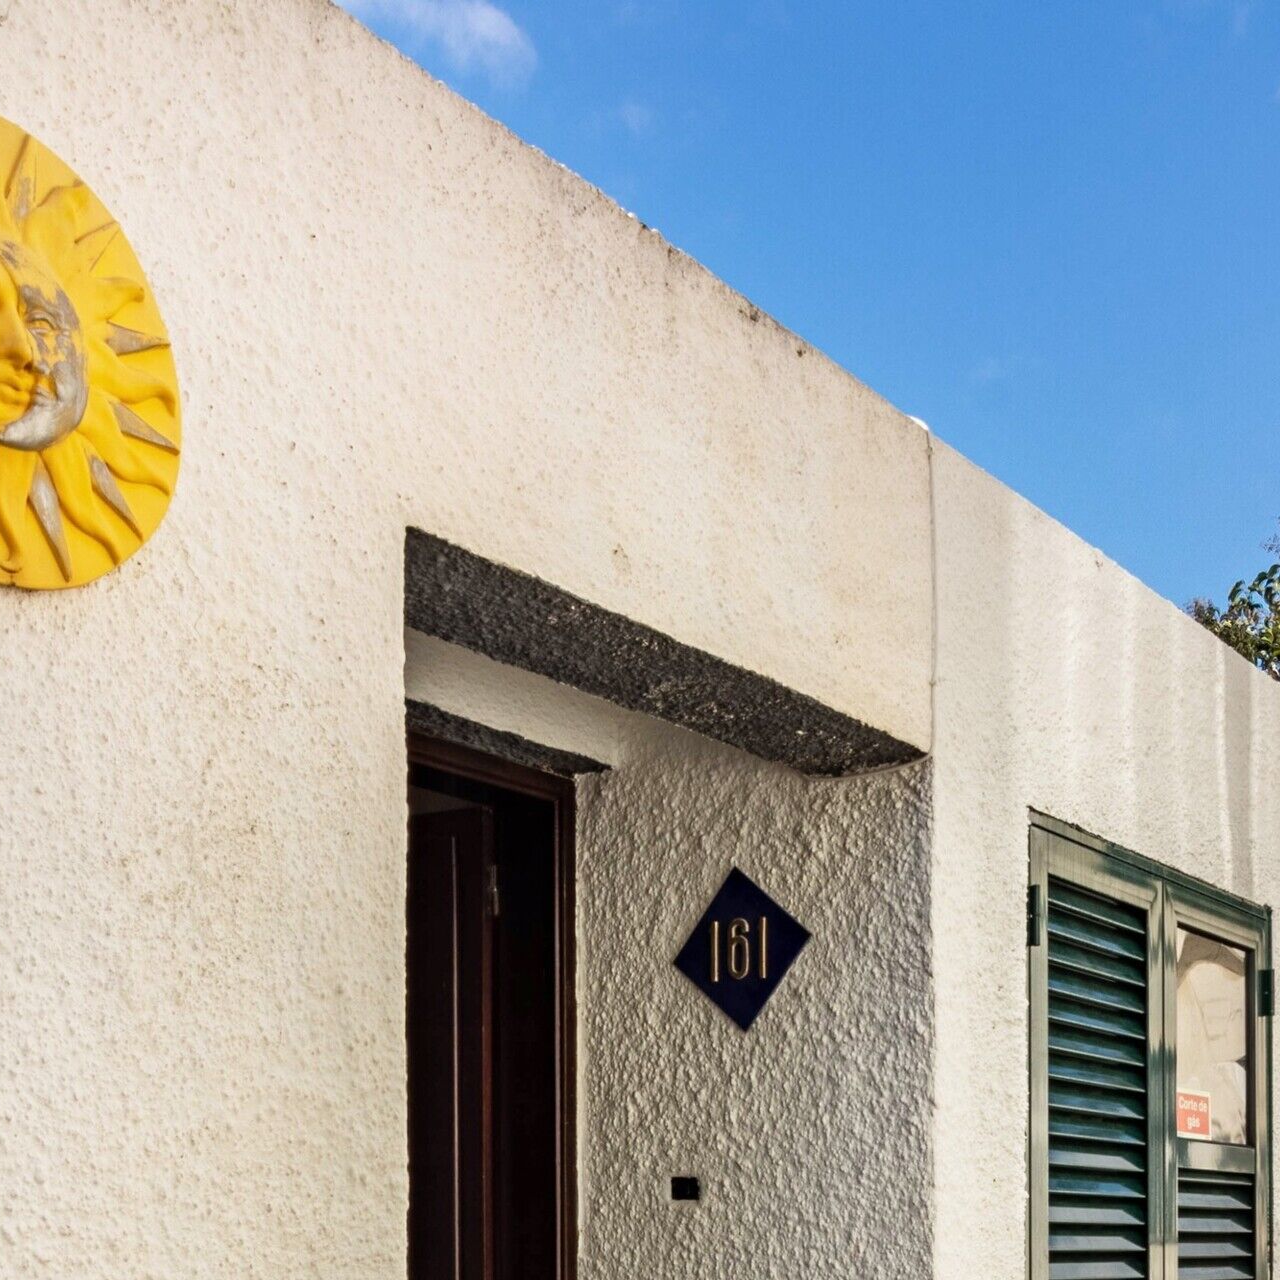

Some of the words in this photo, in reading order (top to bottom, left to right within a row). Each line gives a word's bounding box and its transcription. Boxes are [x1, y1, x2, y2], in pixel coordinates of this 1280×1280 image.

[711, 916, 767, 982] 161
[1178, 1095, 1198, 1111] Corte
[1198, 1099, 1208, 1113] de
